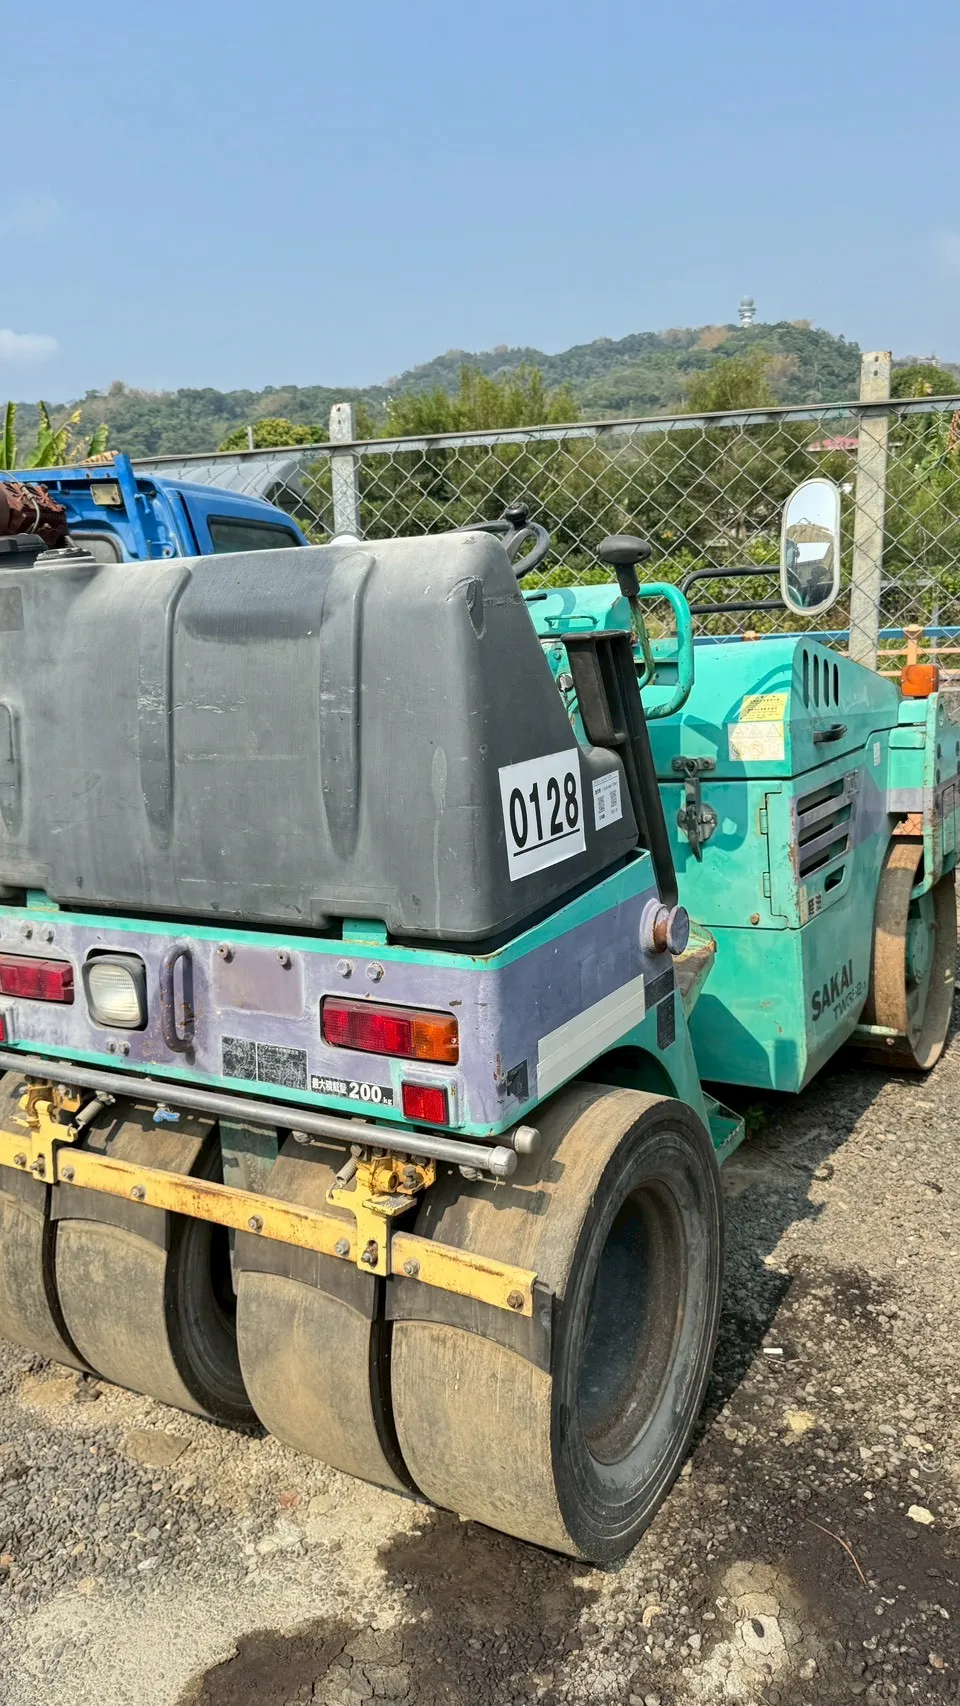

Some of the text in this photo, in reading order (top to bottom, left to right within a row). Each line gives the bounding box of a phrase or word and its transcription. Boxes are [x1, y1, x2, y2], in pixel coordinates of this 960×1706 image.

[509, 771, 579, 848] 0128
[811, 958, 853, 1021] SAKAI
[349, 1081, 382, 1103] 200
[383, 1096, 393, 1106] kg
